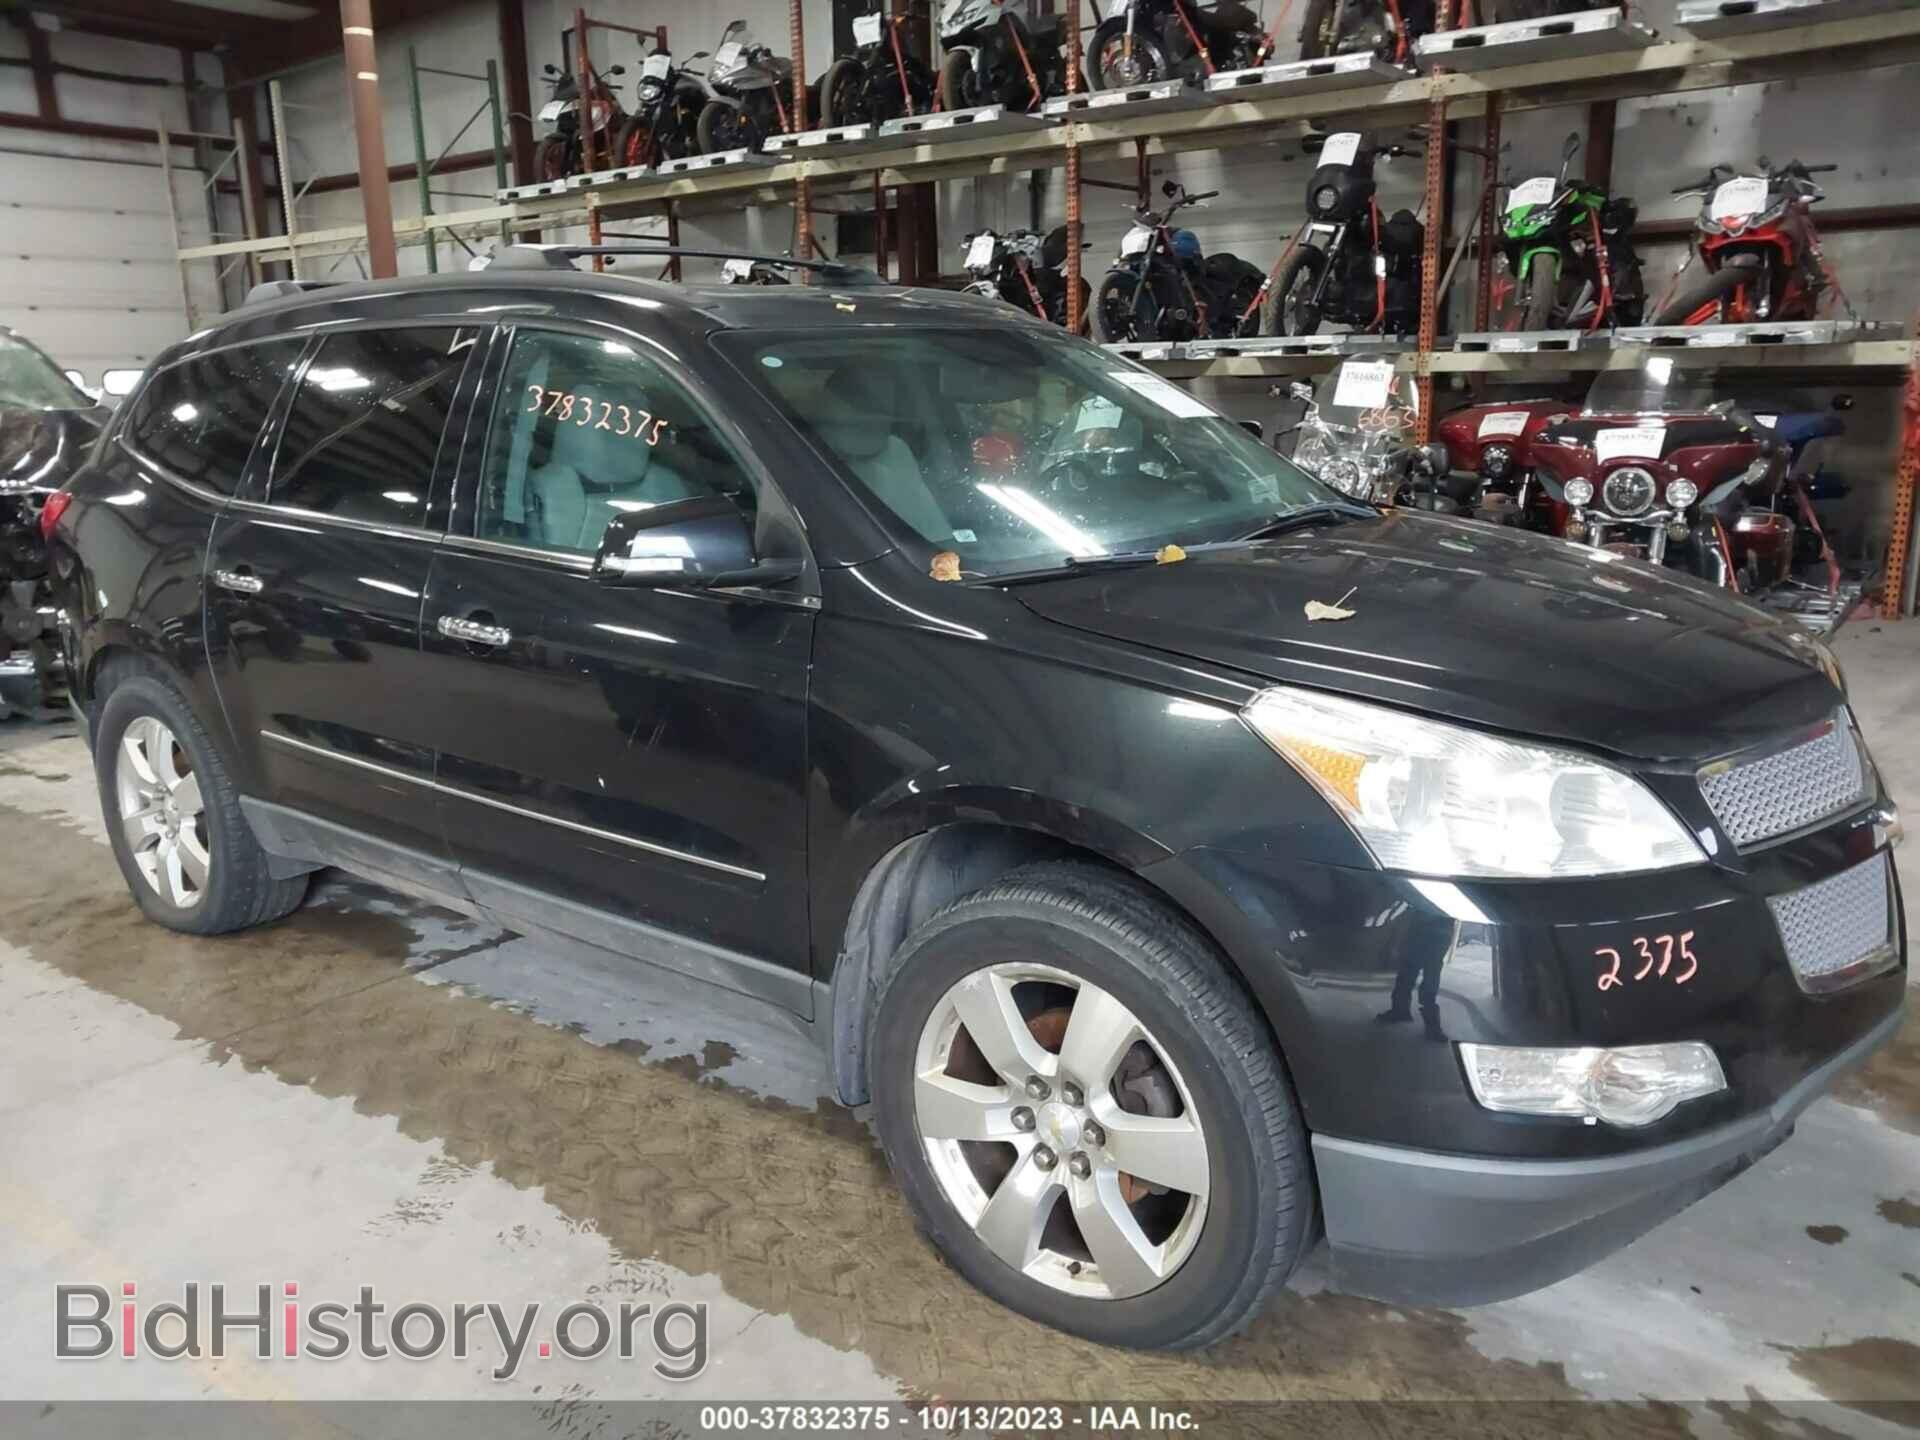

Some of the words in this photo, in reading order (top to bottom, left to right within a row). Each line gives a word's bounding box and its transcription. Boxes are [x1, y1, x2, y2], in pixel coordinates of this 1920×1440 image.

[527, 384, 669, 447] 37832375
[1357, 405, 1415, 429] 6863
[1594, 929, 1698, 991] 2375
